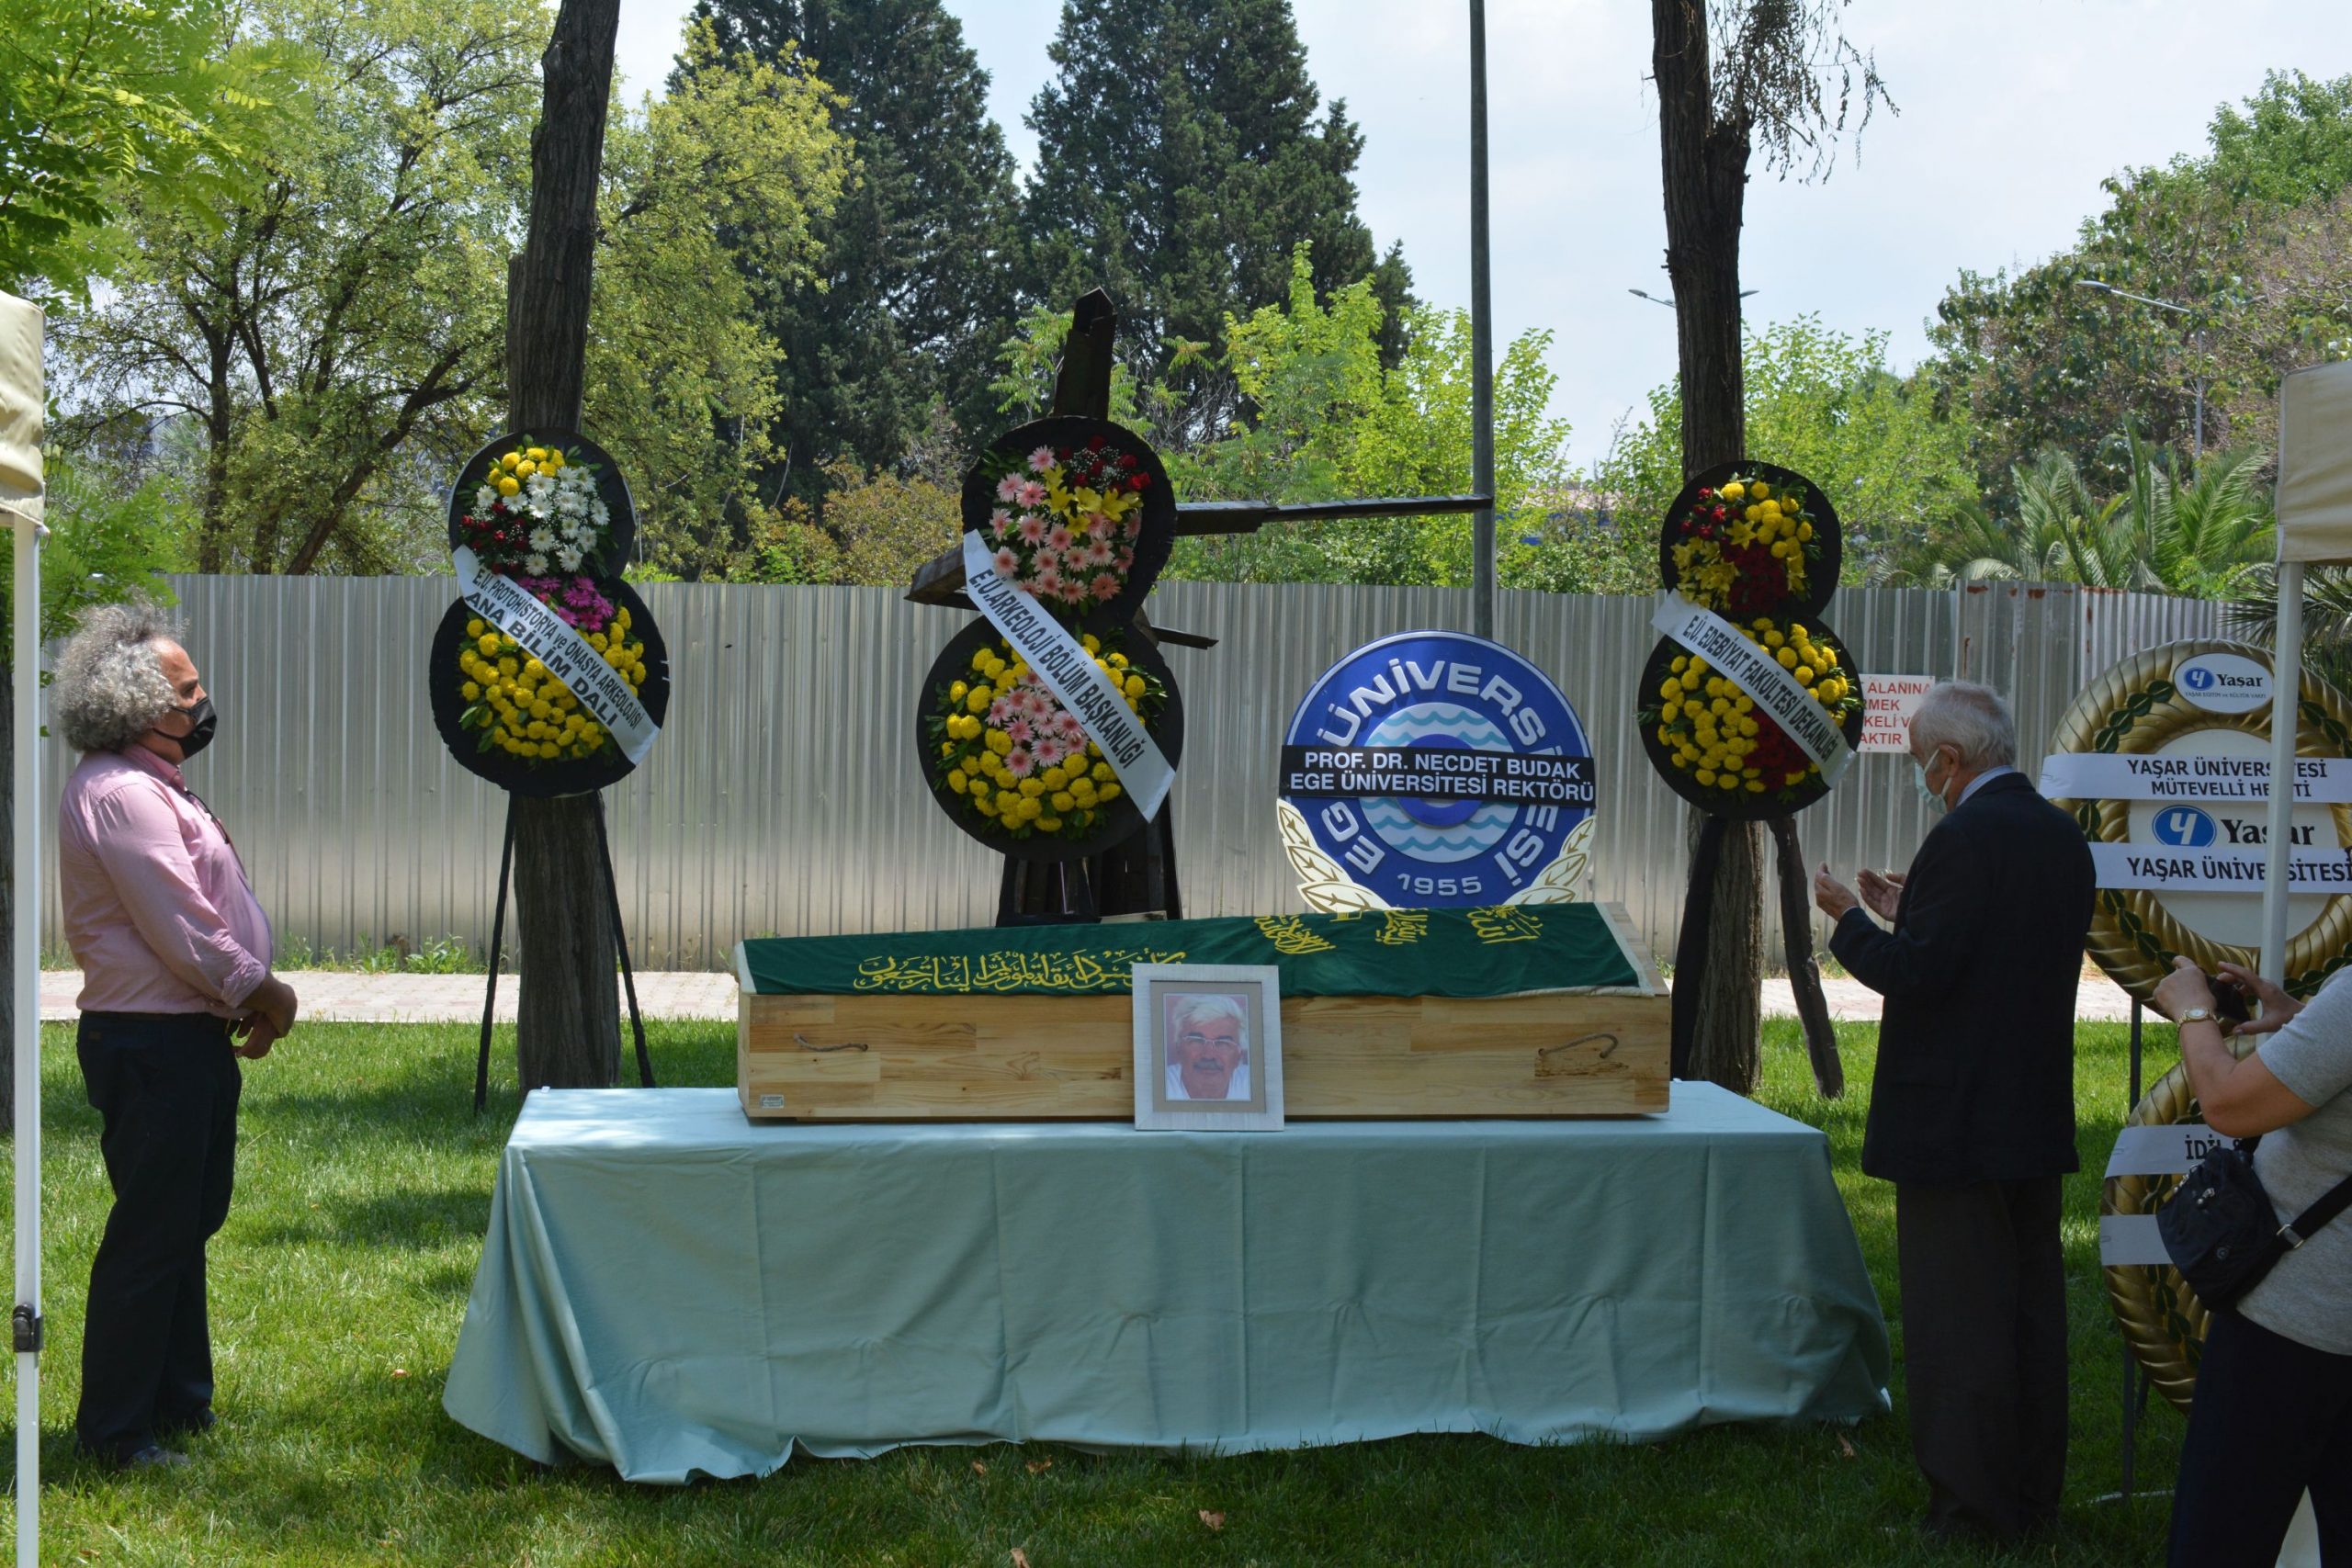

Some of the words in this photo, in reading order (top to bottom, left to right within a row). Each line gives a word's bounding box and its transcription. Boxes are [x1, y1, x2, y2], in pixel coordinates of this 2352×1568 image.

[465, 592, 505, 625] ANA
[507, 620, 572, 678] BİLİM
[571, 676, 618, 727] DALI
[552, 633, 568, 649] ve
[565, 637, 604, 682] ÖNASYA
[1697, 626, 1752, 671] EDEBİYAT
[1739, 659, 1805, 719] FAKÜLTESİ
[2216, 673, 2264, 688] Yaşar
[1038, 644, 1091, 696] BÖLÜM
[1073, 682, 1147, 770] BAŞKANLIĞI
[1863, 713, 1896, 728] KELİ
[1860, 732, 1902, 745] AKTIR
[1305, 751, 1366, 770] PROF.
[1373, 752, 1408, 770] DR.
[1415, 753, 1500, 774] NECDET
[1507, 758, 1580, 780] BUDAK
[2127, 759, 2189, 779] YAŞAR
[2194, 757, 2328, 778] ÜNİVERESİ
[1290, 773, 1335, 790] EGE
[1341, 770, 1487, 795] ÜNİVERSİTESİ
[1493, 779, 1594, 802] REKTÖRÜ
[2151, 778, 2246, 796] MÜTEVELLİ
[2251, 780, 2312, 797] HETİ
[2127, 857, 2198, 882] YAŞAR
[2202, 856, 2352, 882] ÜNİVESİTESİ
[1396, 872, 1483, 897] 1955
